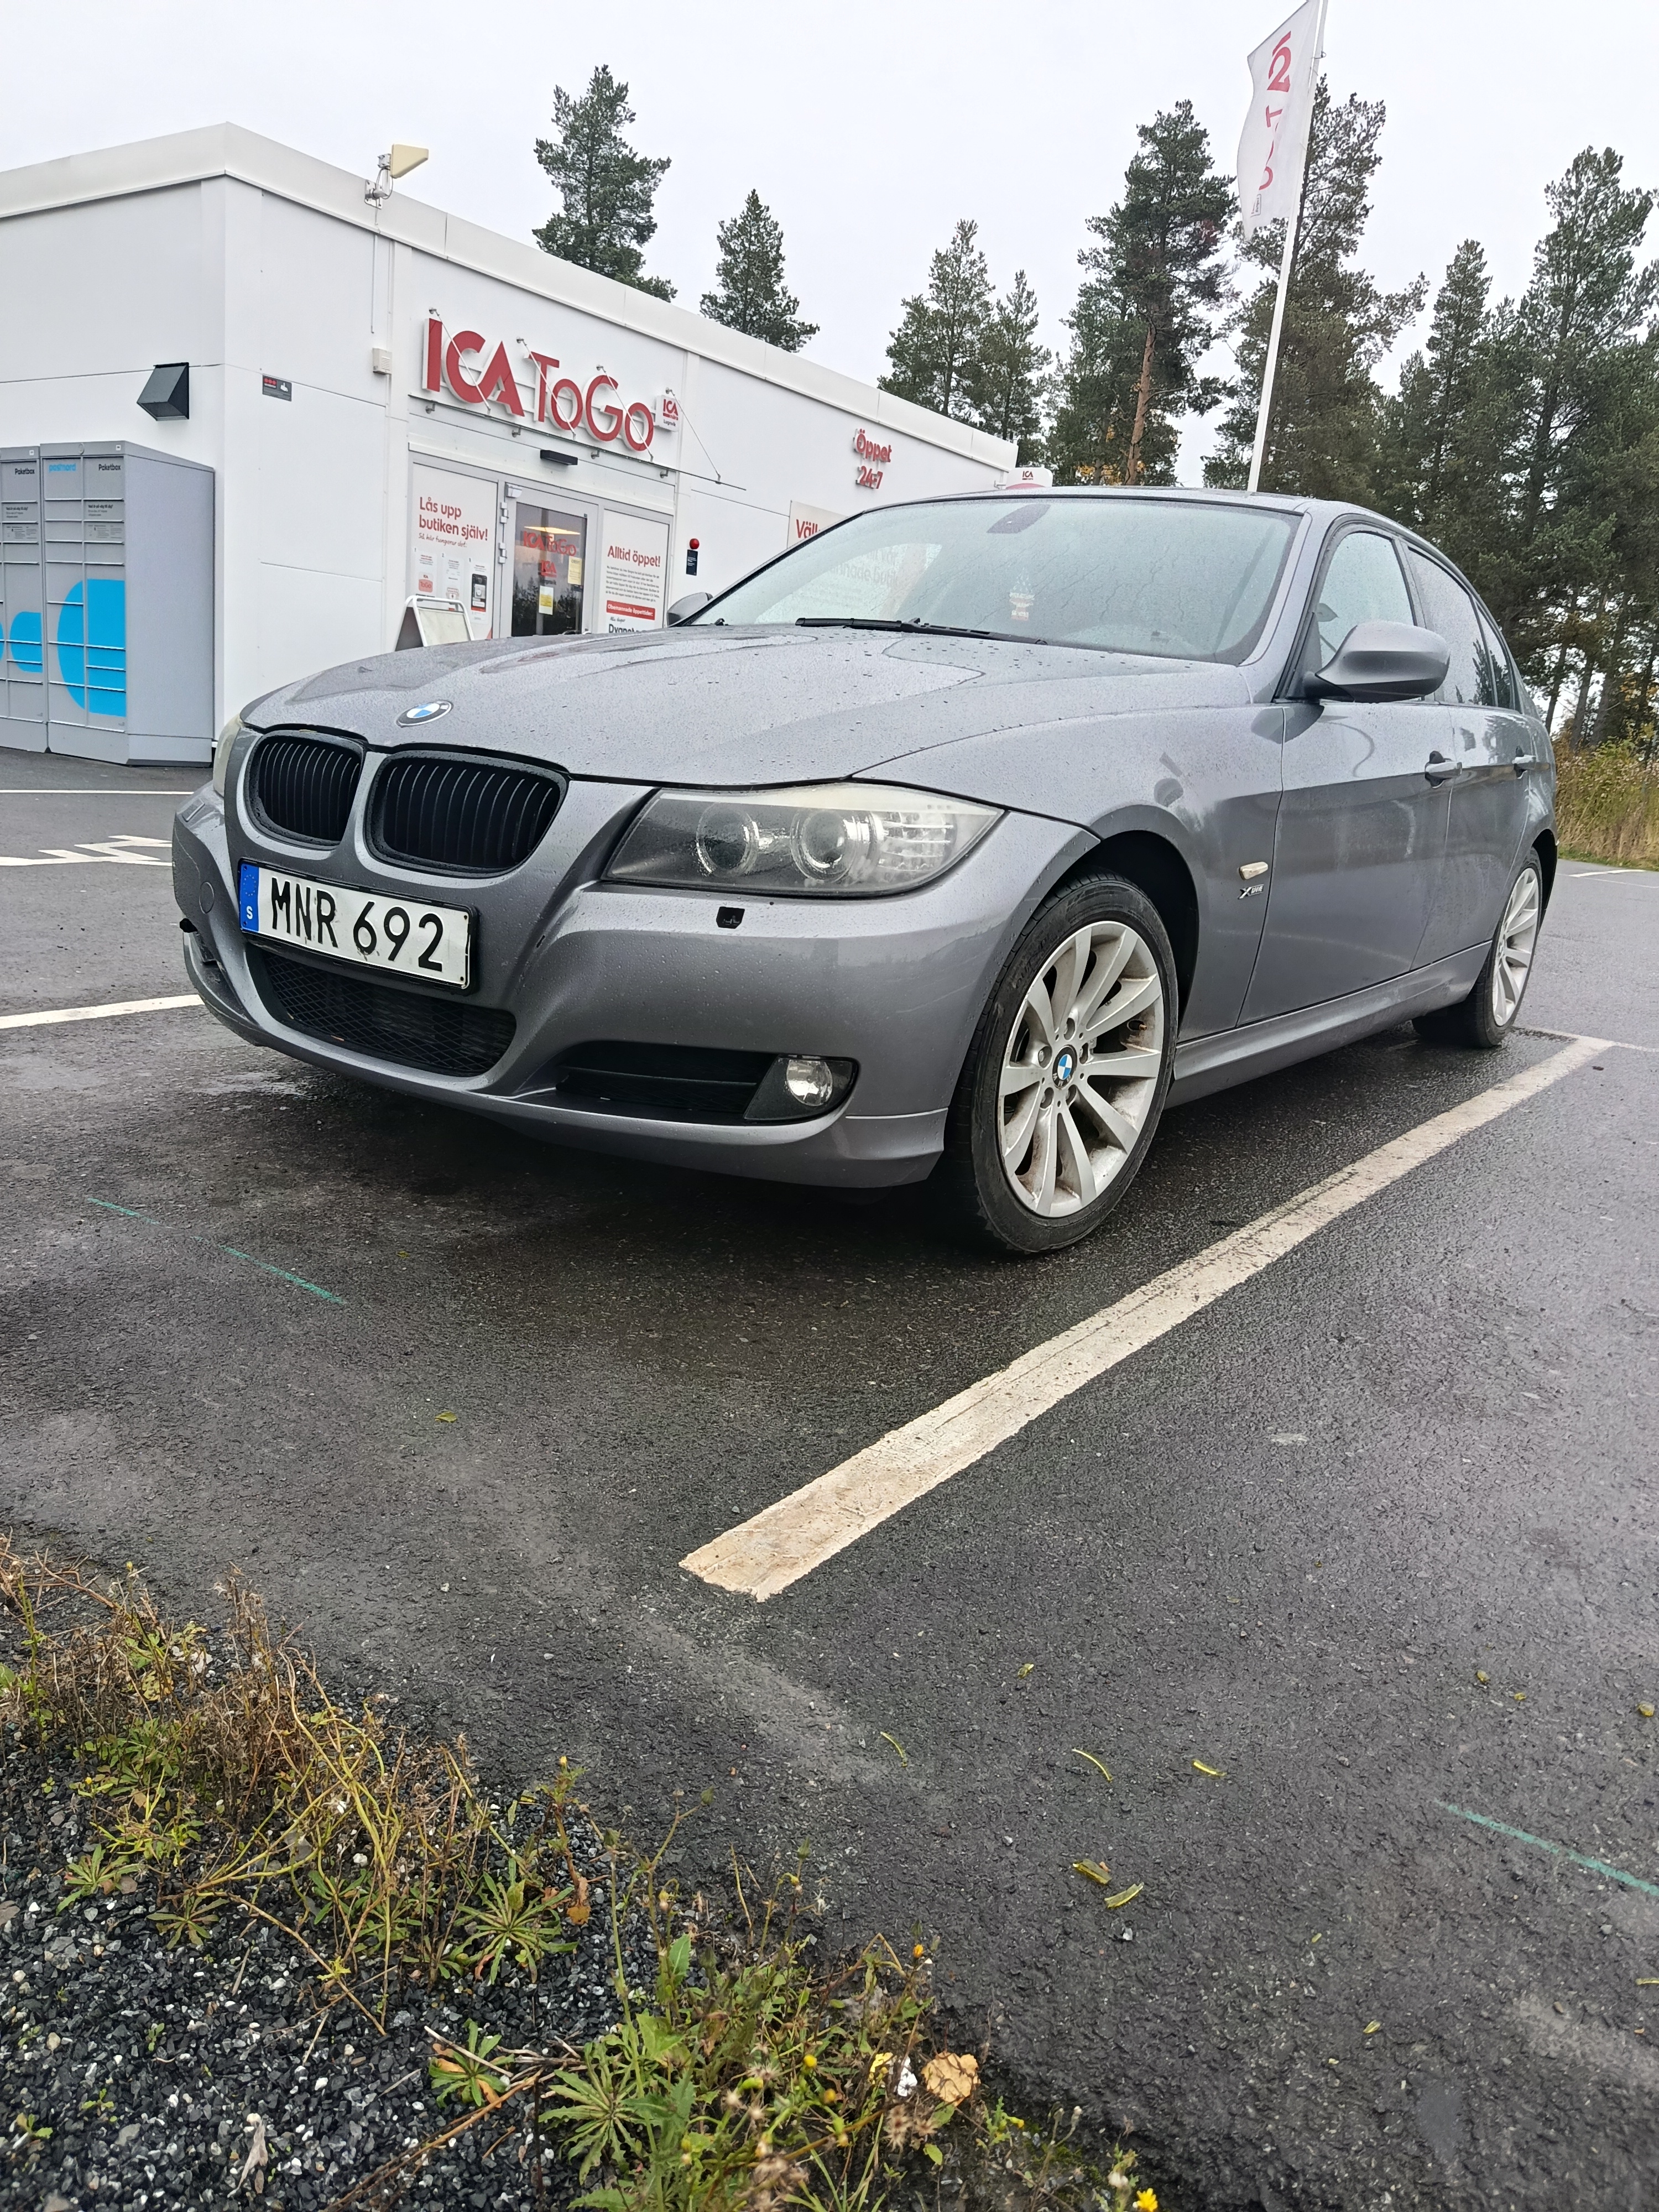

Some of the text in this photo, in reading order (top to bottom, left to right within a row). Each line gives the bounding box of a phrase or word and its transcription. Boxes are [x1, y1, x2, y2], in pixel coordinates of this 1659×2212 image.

[426, 318, 654, 451] ICA ToGo
[663, 399, 678, 416] ICA
[857, 428, 892, 462] Öppet
[98, 463, 121, 471] Paketbox
[420, 496, 462, 520] Lås upp
[419, 514, 488, 541] butiken själv!
[523, 530, 577, 557] ICA ToGo
[540, 559, 557, 574] ICA
[607, 545, 661, 568] Alltid öppet!
[420, 581, 432, 589] ToGo
[246, 905, 254, 920] S
[271, 877, 444, 973] MNR 692
